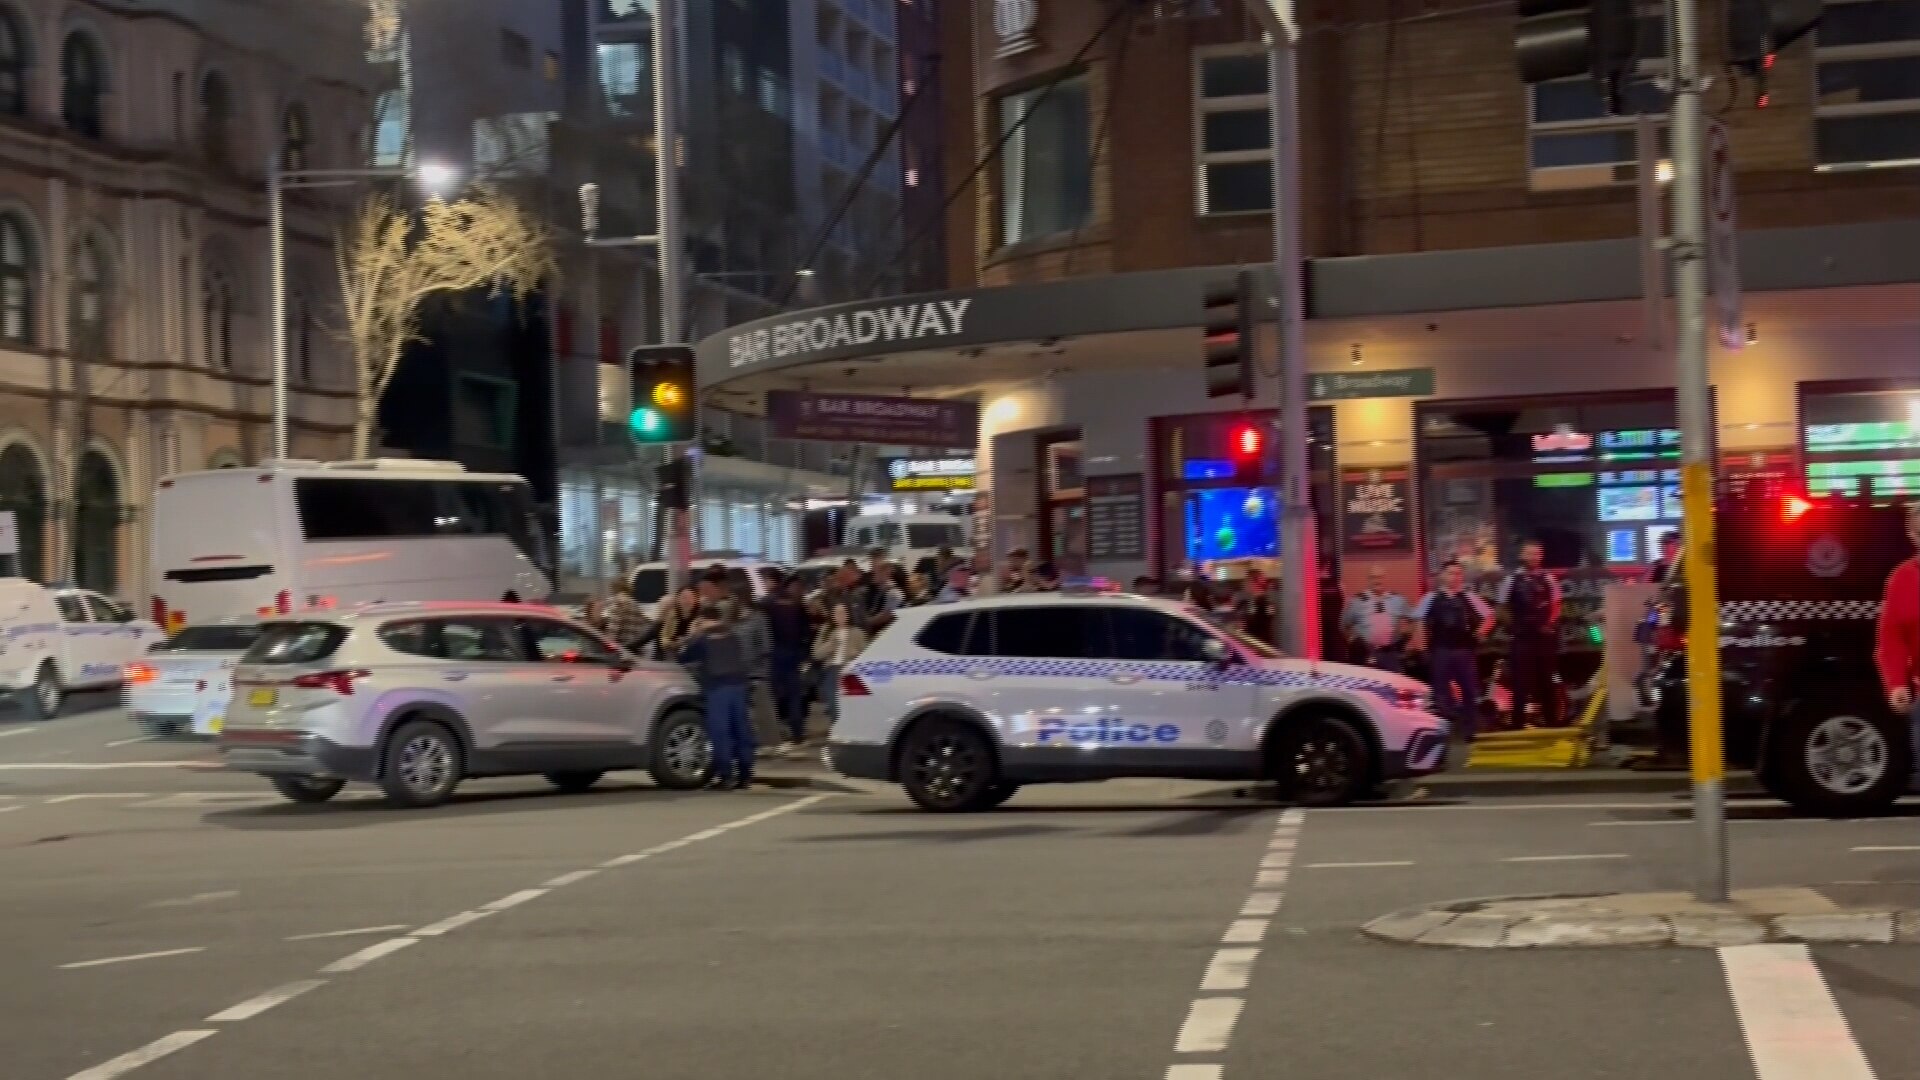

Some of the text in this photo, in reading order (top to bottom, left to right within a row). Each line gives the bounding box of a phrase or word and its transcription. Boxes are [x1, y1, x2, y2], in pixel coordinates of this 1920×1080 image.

[729, 299, 972, 368] BAR BROADWAY
[1335, 374, 1412, 391] Broadway
[818, 399, 940, 418] BAR BROADWAY
[1357, 484, 1395, 498] LIVE
[1348, 498, 1404, 513] MUSIC
[1717, 635, 1806, 648] Police
[1038, 718, 1181, 742] Police
